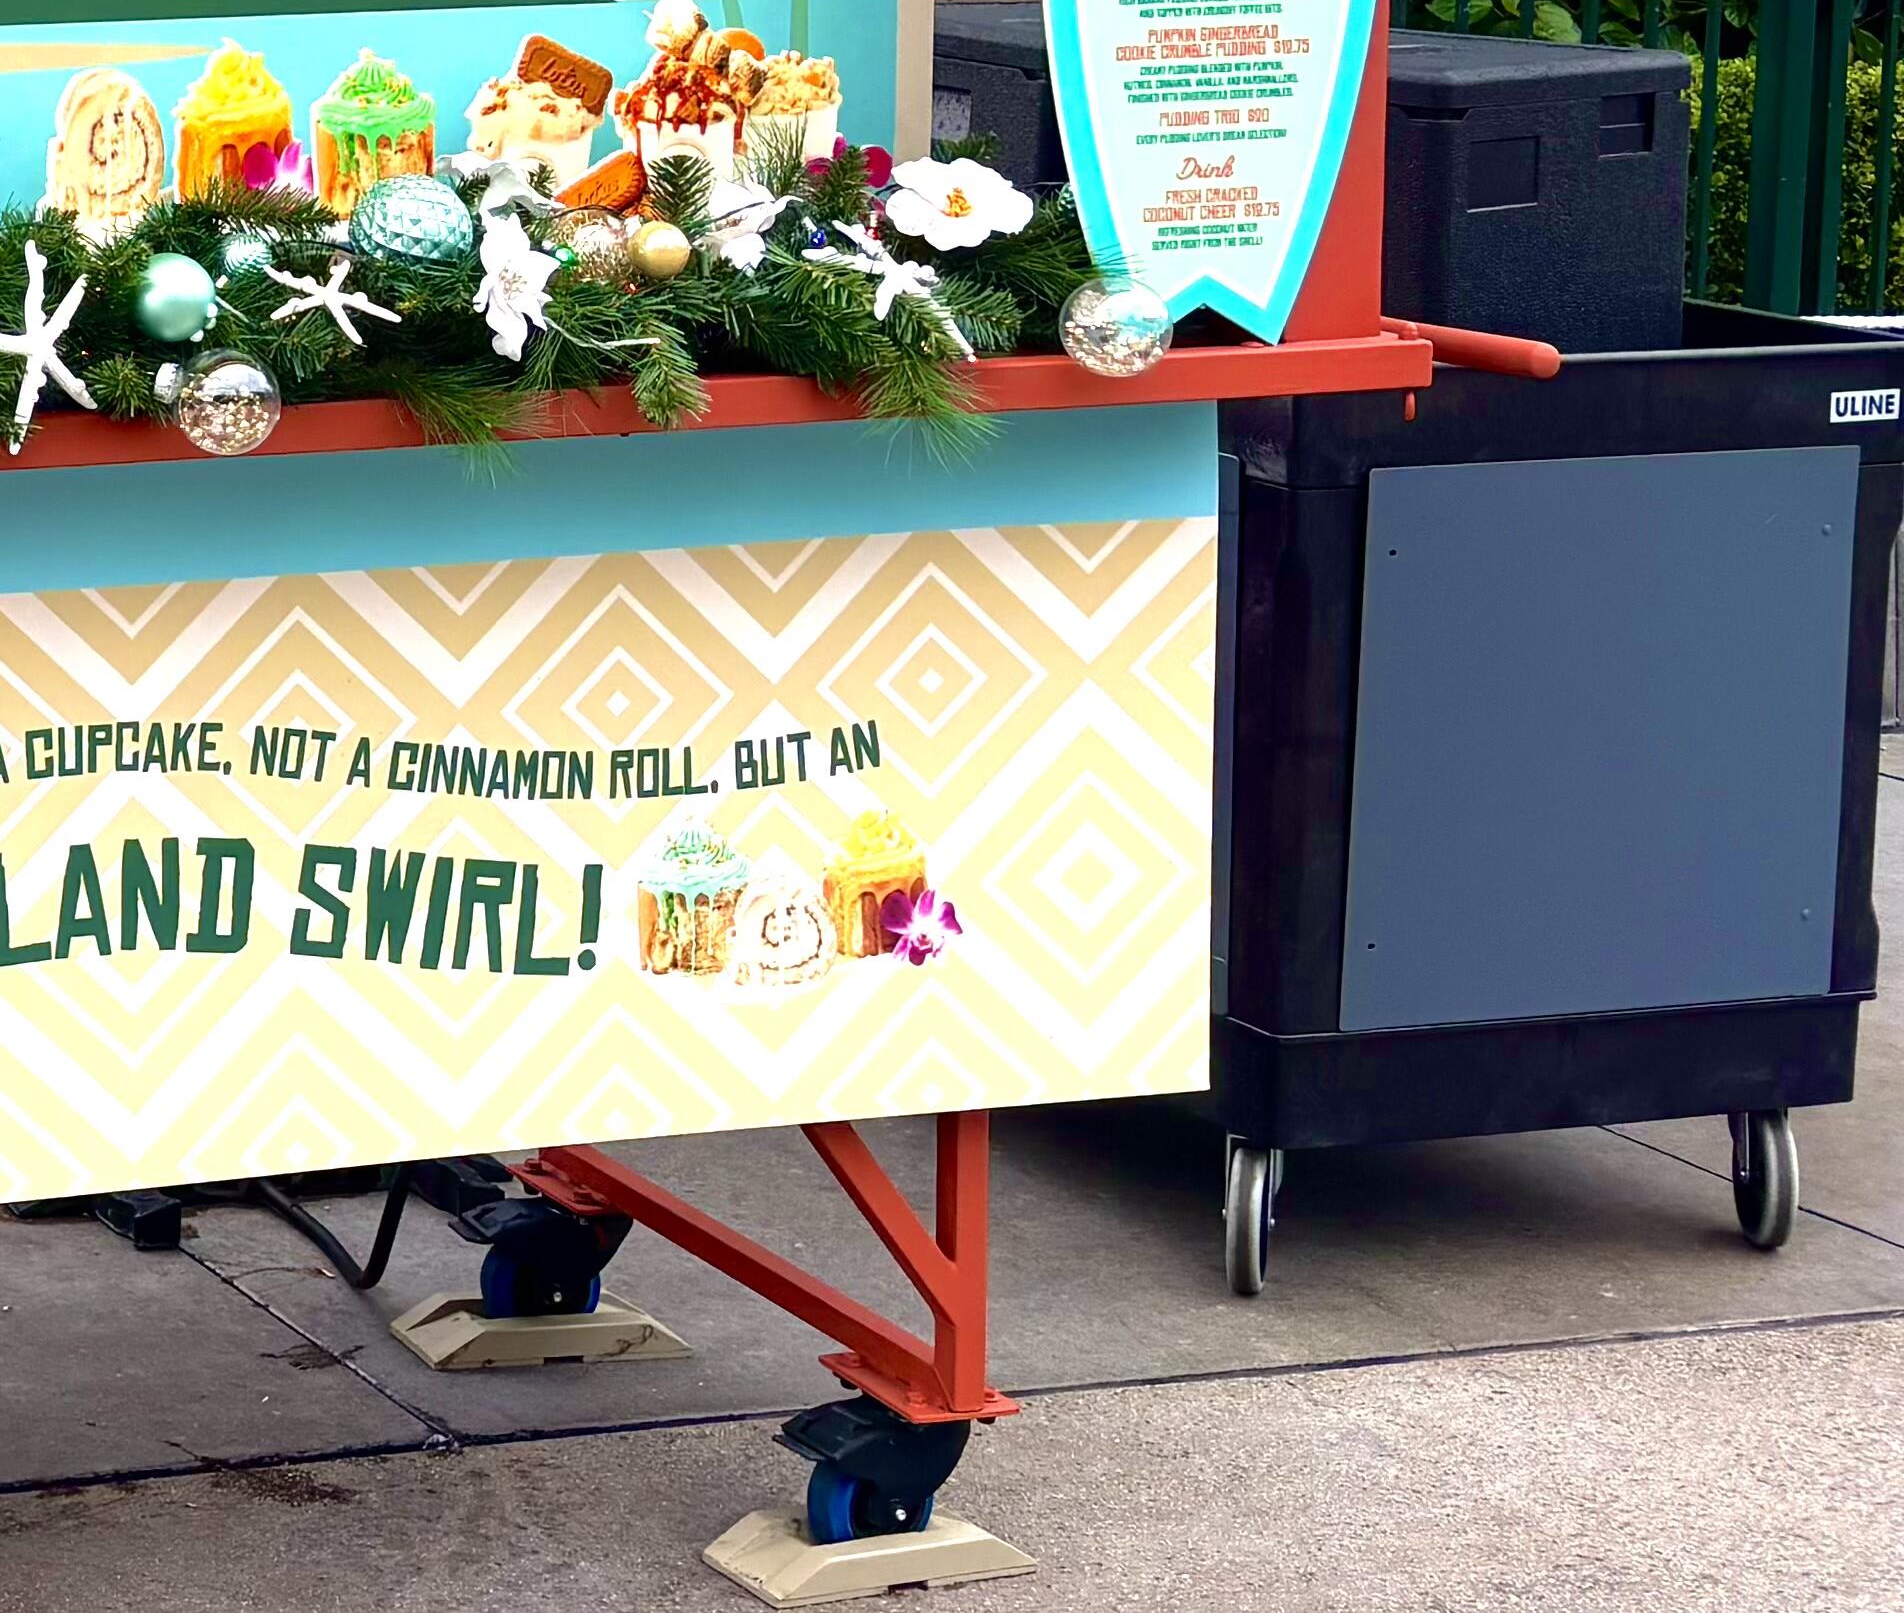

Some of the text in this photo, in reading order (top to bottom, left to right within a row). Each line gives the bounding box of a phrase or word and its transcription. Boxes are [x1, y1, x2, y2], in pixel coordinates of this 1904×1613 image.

[1148, 24, 1279, 43] PUMPKIN GINGERBREAD
[1116, 45, 1157, 61] COOKIE
[1161, 43, 1212, 60] CRUMBLE
[1216, 40, 1267, 57] PUDDING
[1160, 111, 1210, 126] PUDDING
[1214, 109, 1240, 125] TRIO
[1176, 155, 1235, 181] Drink
[1166, 186, 1258, 205] FRESH CRACKED
[1143, 206, 1197, 223] COCONUT
[1200, 204, 1236, 220] CHEER
[1835, 394, 1895, 417] ULINE
[251, 729, 335, 778] NOT
[346, 741, 371, 788] A
[388, 748, 592, 801] CINNAMON
[734, 732, 811, 790] BUT
[828, 720, 881, 772] AN
[290, 844, 604, 976] SWIRL!
